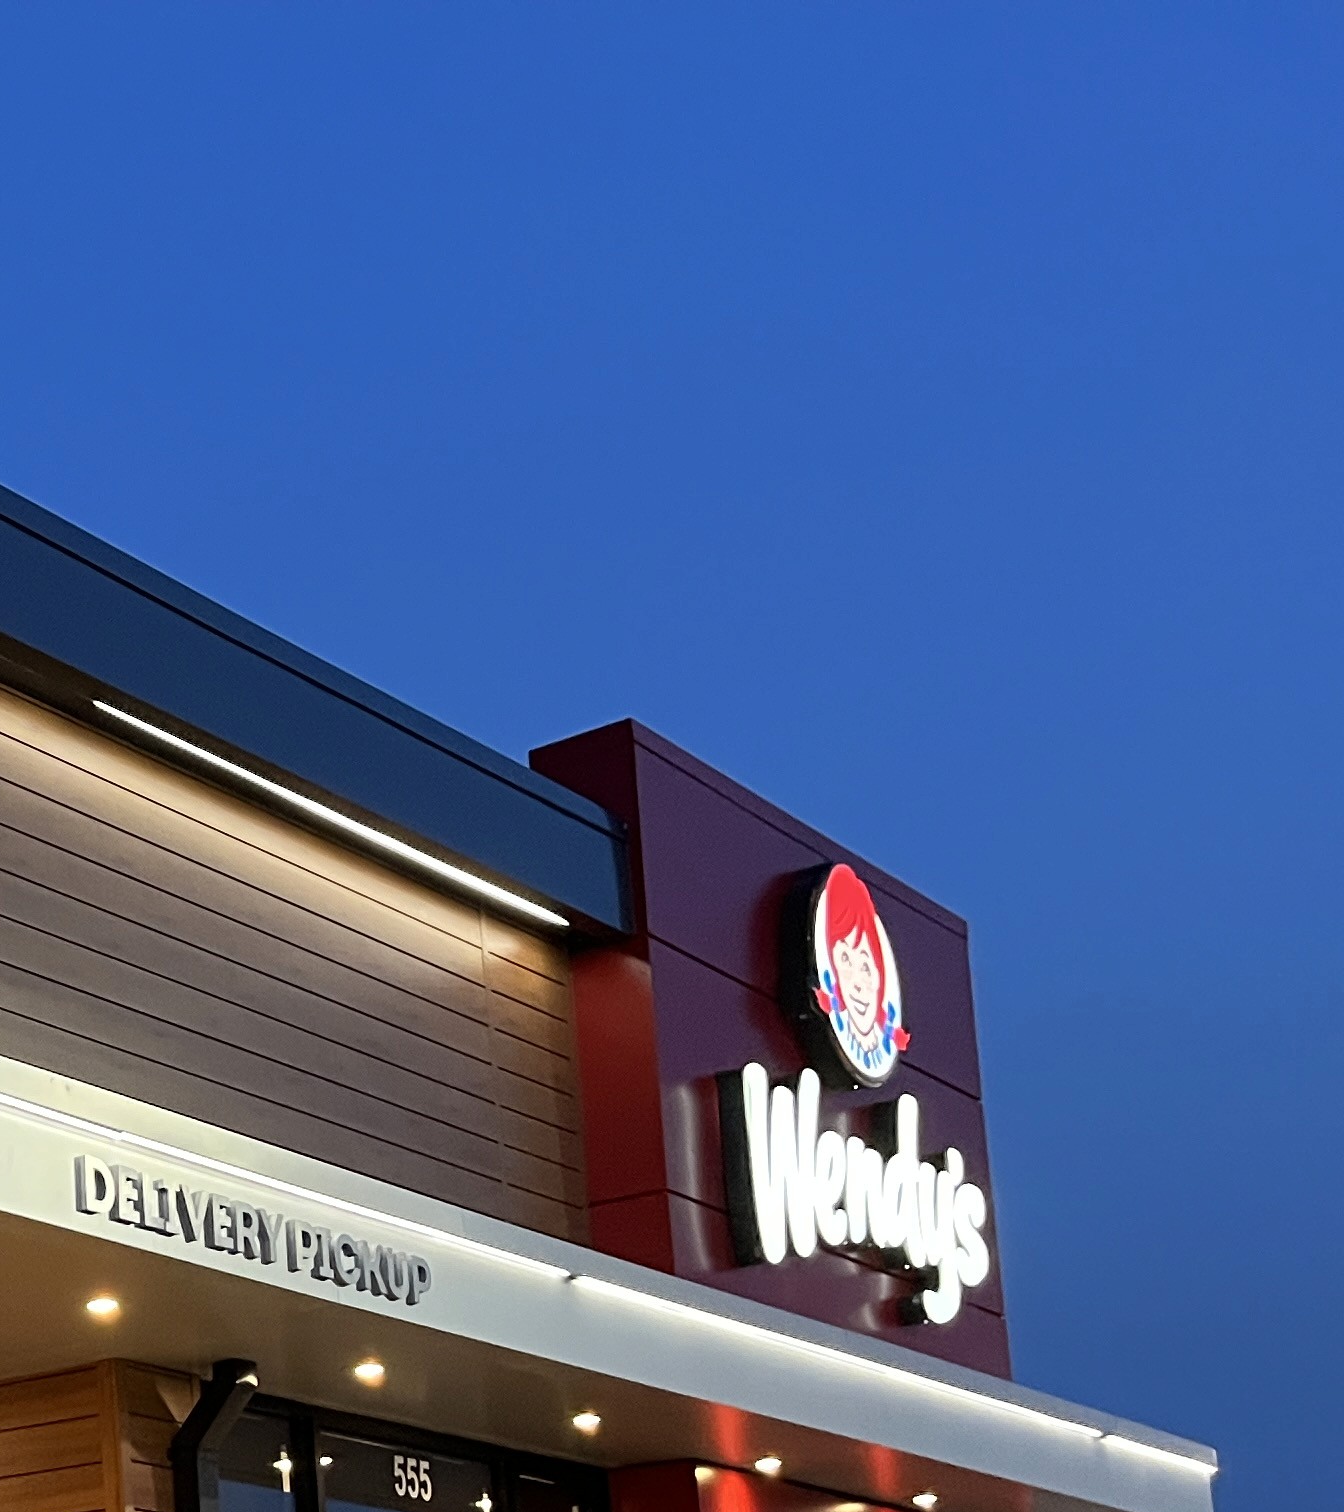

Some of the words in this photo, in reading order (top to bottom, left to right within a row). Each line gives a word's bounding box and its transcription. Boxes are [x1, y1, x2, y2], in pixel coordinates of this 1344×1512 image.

[73, 1153, 284, 1266] DELIVERY
[285, 1219, 433, 1306] PICKUP
[742, 1061, 990, 1324] Wendy's
[393, 1454, 433, 1502] 555
